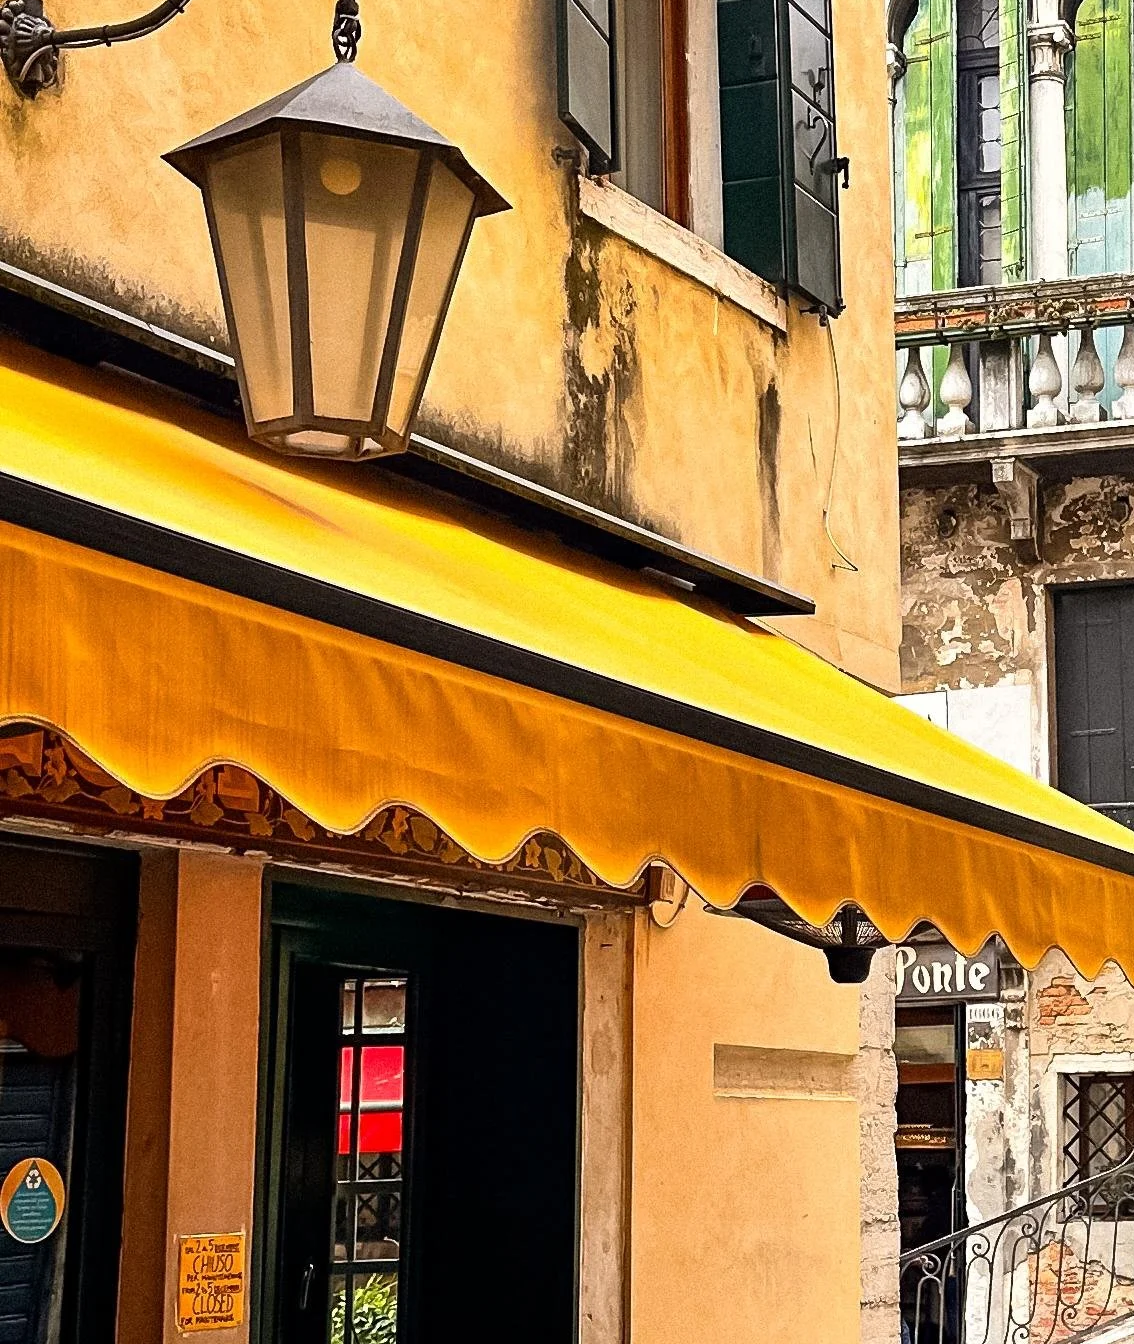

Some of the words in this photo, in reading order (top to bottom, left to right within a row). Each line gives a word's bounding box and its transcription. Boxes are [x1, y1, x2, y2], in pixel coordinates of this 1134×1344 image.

[896, 946, 990, 996] Ponte
[193, 1254, 234, 1274] CHIUSO
[193, 1294, 235, 1316] CLOSED
